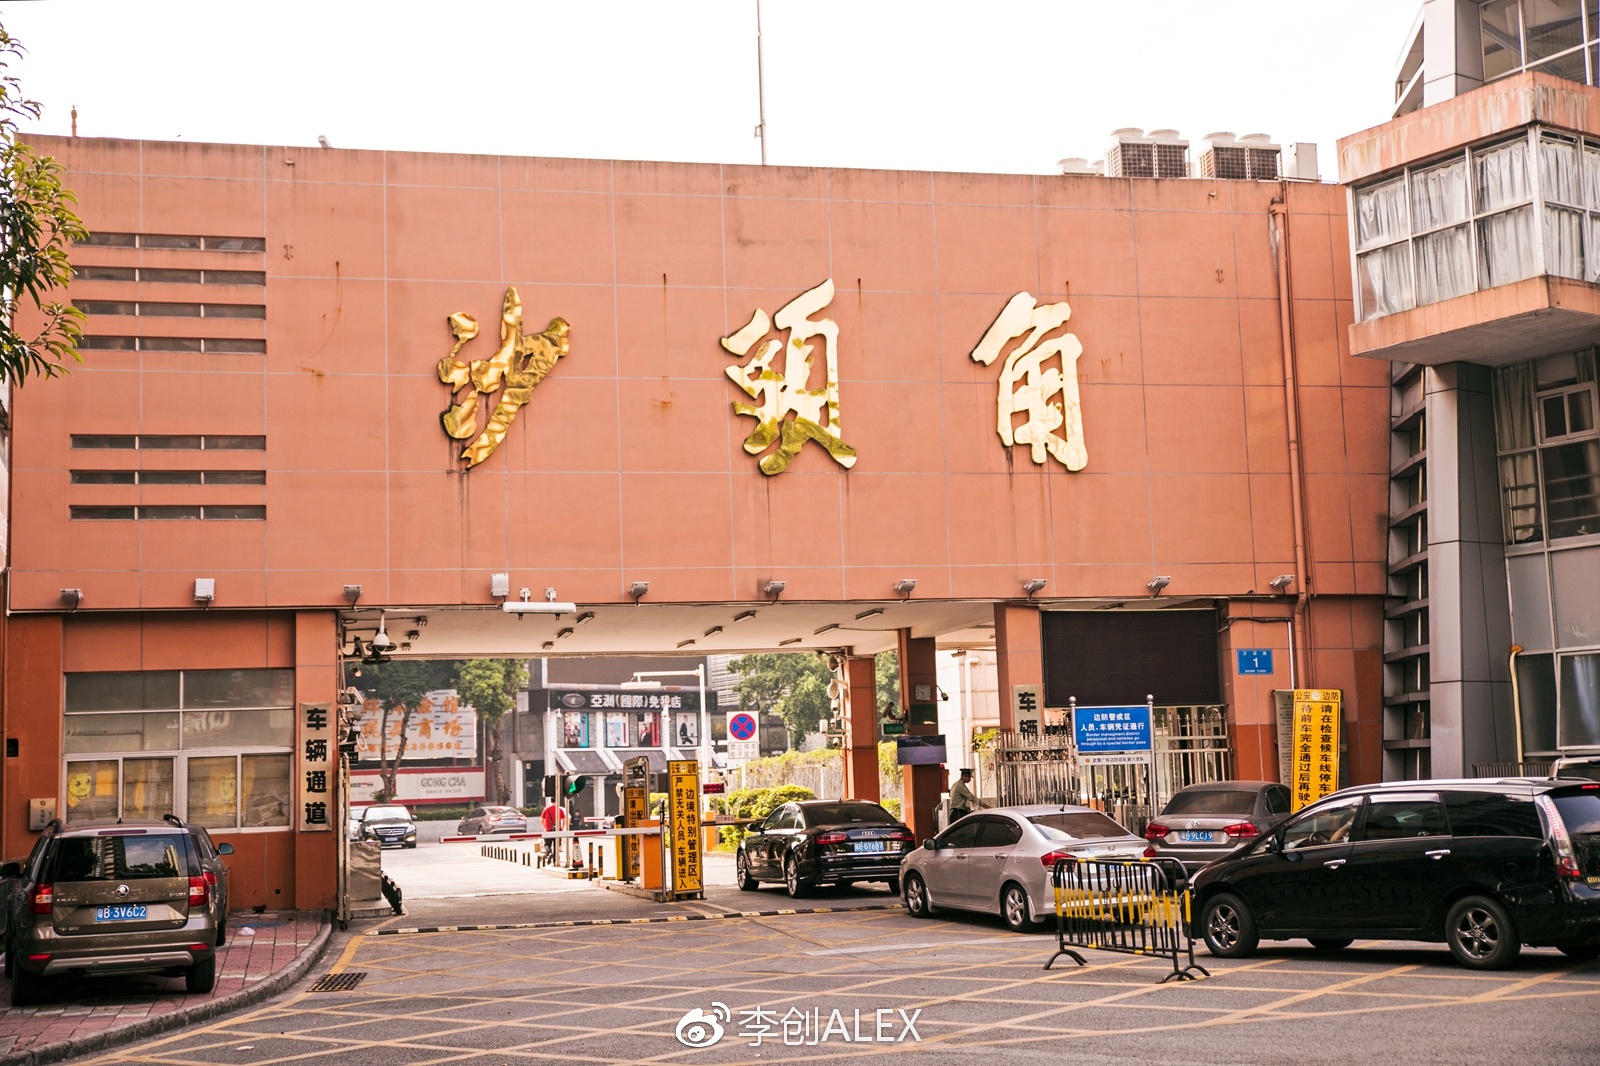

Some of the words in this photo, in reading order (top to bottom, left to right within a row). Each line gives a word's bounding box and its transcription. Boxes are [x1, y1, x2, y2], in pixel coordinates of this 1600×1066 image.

[1253, 657, 1258, 668] 1
[1295, 691, 1311, 700] 公安
[1322, 691, 1339, 700] 边防
[1093, 713, 1131, 721] 边防警戒区
[1080, 722, 1145, 732] 人员、车辆凭证通行
[1298, 704, 1313, 810] 待前车完全通过后再驶入
[305, 708, 327, 825] 车辆通道
[420, 777, 447, 788] GONG
[685, 788, 698, 877] 边境特别管理区
